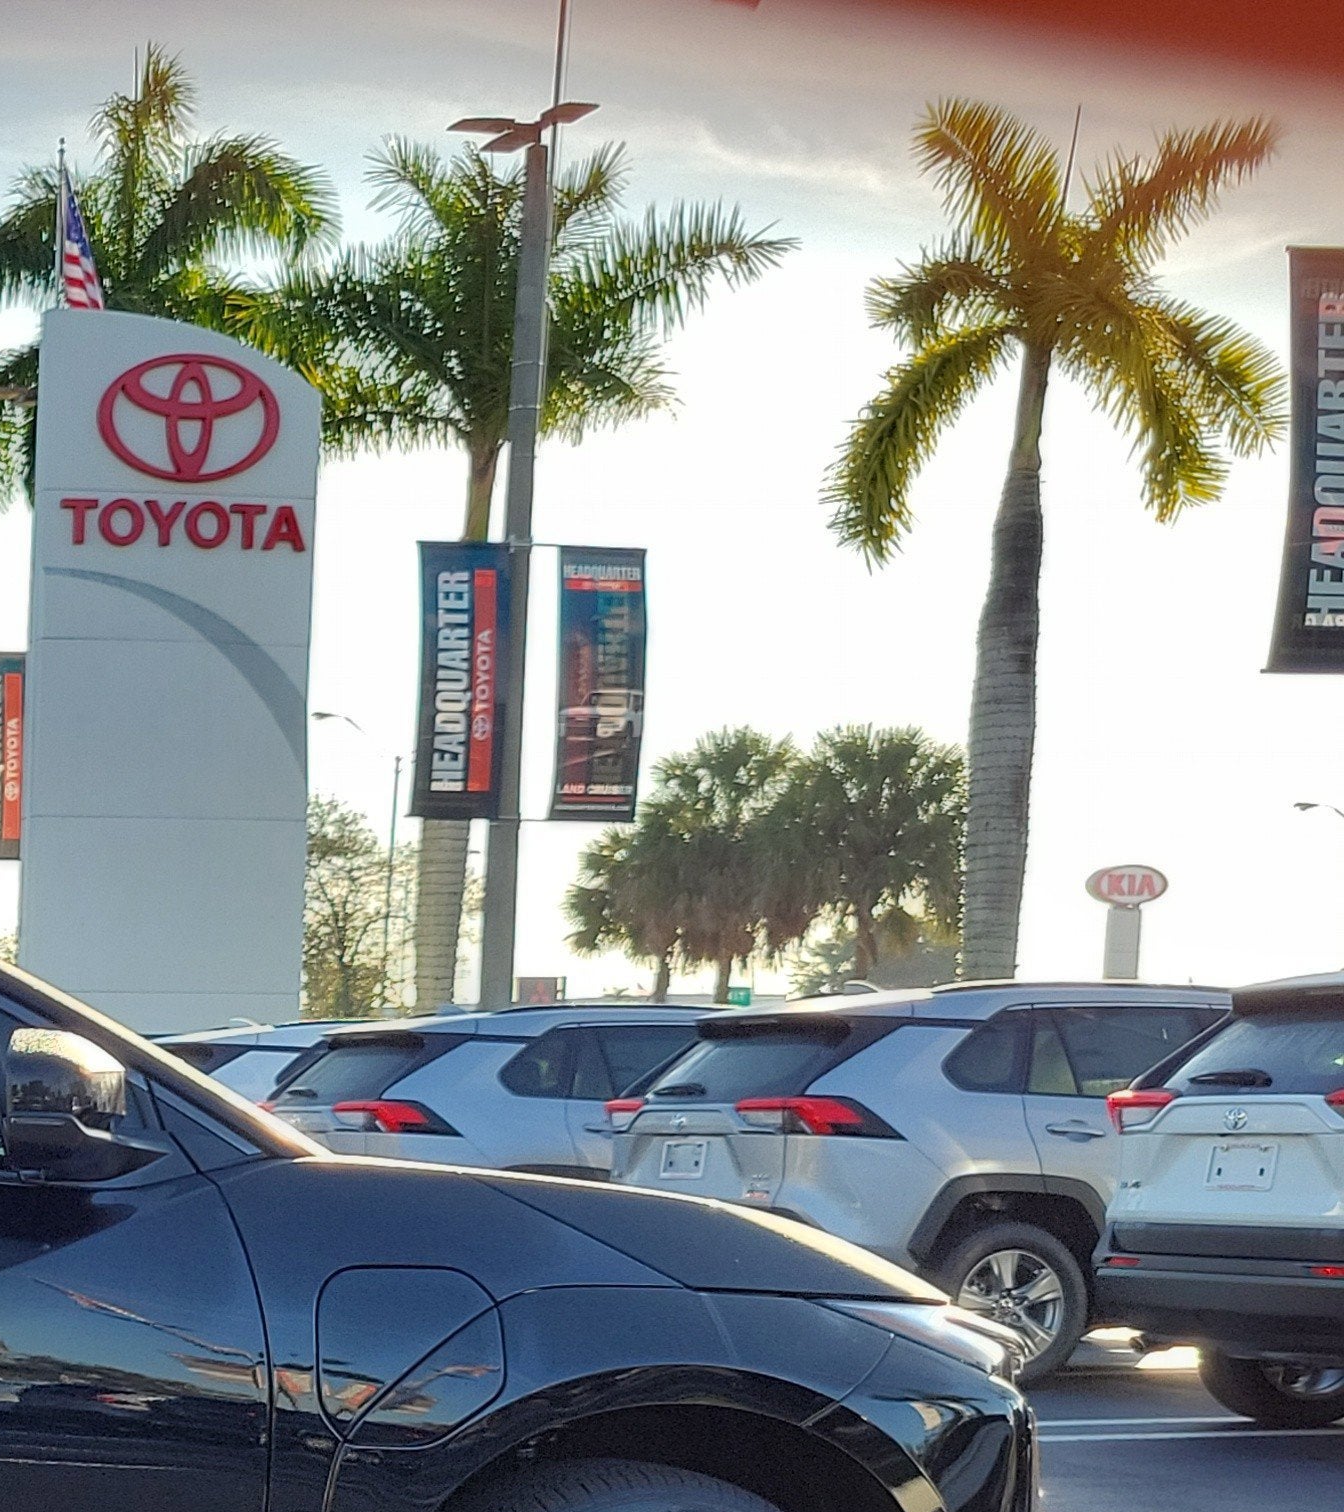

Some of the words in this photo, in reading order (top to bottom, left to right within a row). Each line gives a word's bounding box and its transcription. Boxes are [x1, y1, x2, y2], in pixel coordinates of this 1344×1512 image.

[60, 498, 305, 551] TOYOTA
[429, 570, 472, 792] HEADQUARTER
[475, 629, 493, 711] TOYOTA
[6, 718, 20, 778] TOYOTA
[1107, 873, 1156, 896] KIA
